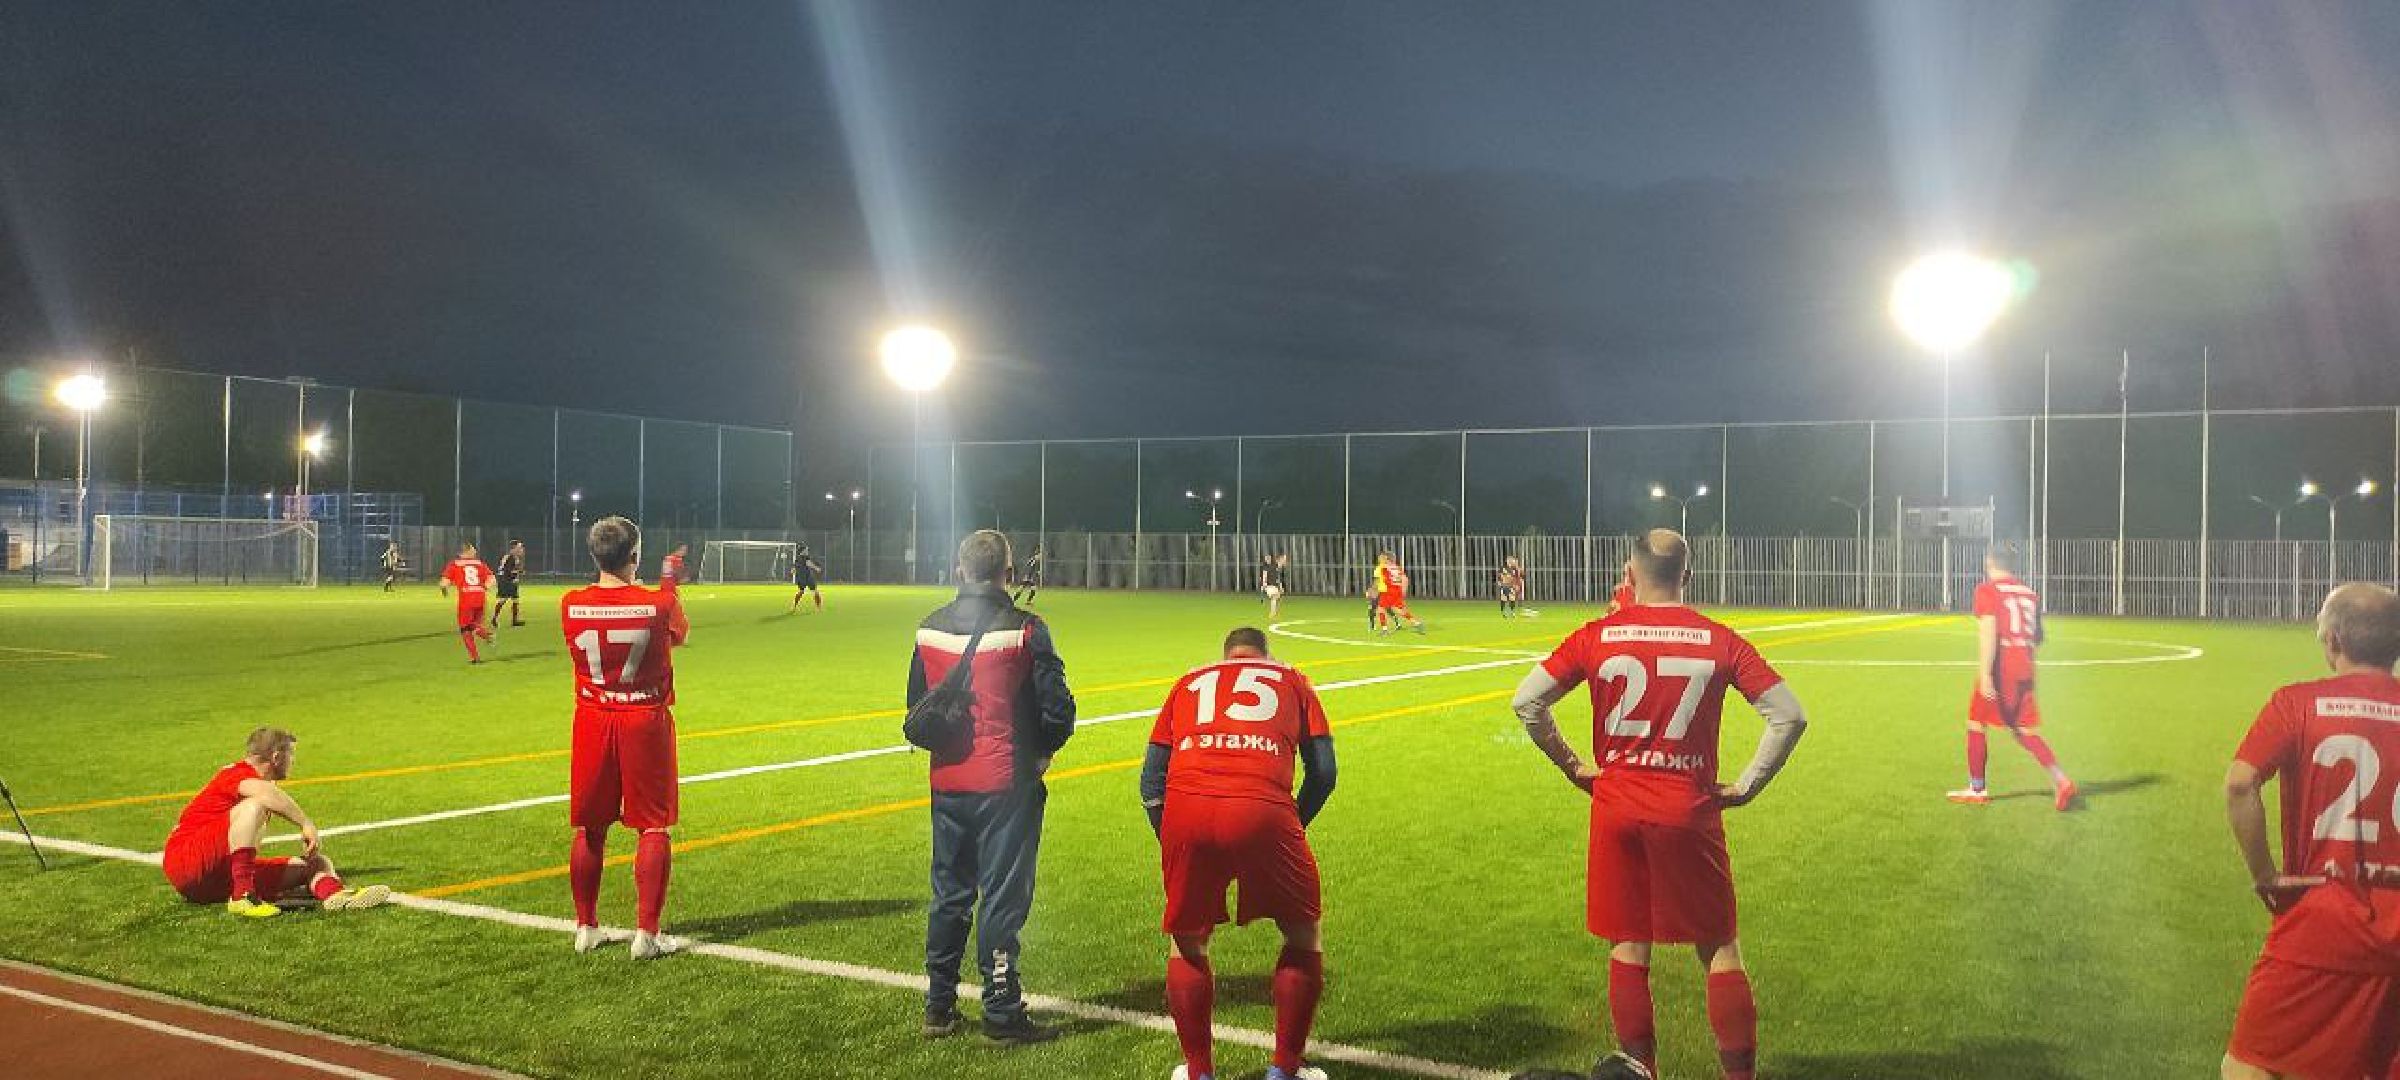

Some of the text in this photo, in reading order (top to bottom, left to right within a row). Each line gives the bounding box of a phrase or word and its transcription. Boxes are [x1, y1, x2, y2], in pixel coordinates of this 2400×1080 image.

[574, 629, 651, 684] 17
[1187, 668, 1282, 725] 15
[1598, 655, 1715, 740] 27
[2313, 734, 2400, 843] 2
